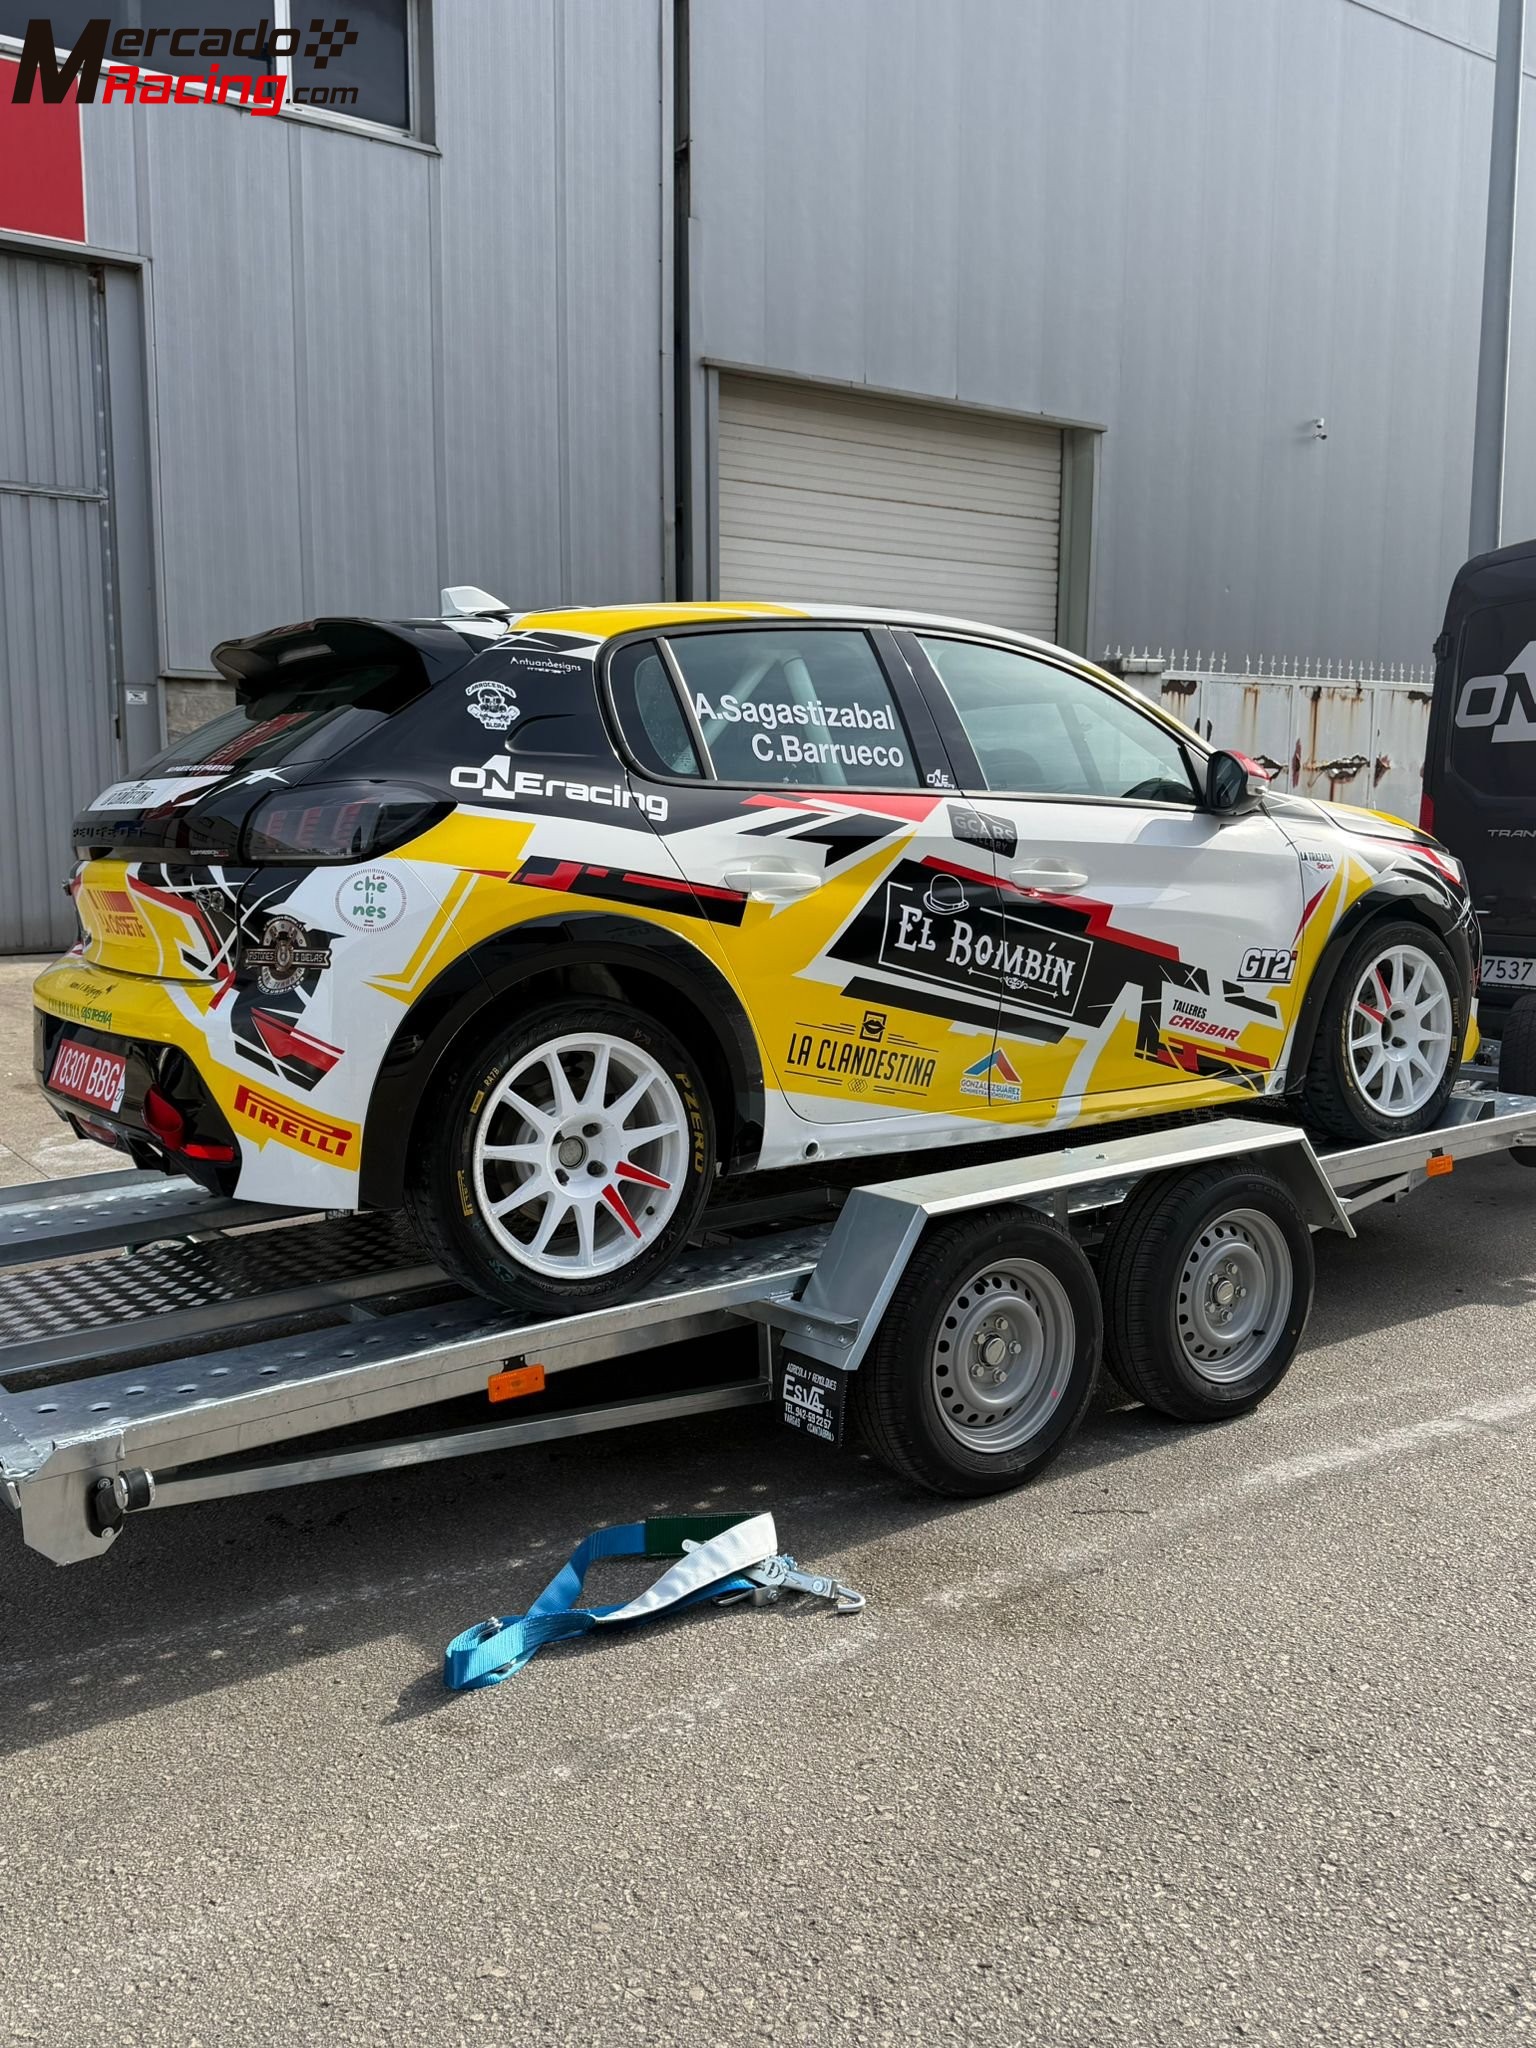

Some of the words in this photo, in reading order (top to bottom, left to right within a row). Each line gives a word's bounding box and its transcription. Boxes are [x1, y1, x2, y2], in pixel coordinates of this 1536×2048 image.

[695, 693, 896, 730] A.Sagastizabal
[751, 733, 904, 767] C.Barrueco
[1483, 959, 1533, 981] 7537
[1172, 999, 1207, 1019] TALLERES
[1168, 1015, 1240, 1041] CRISBAR
[787, 1033, 812, 1065] LA
[816, 1037, 937, 1088] CLANDESTINA
[234, 1084, 353, 1156] PIRELLI
